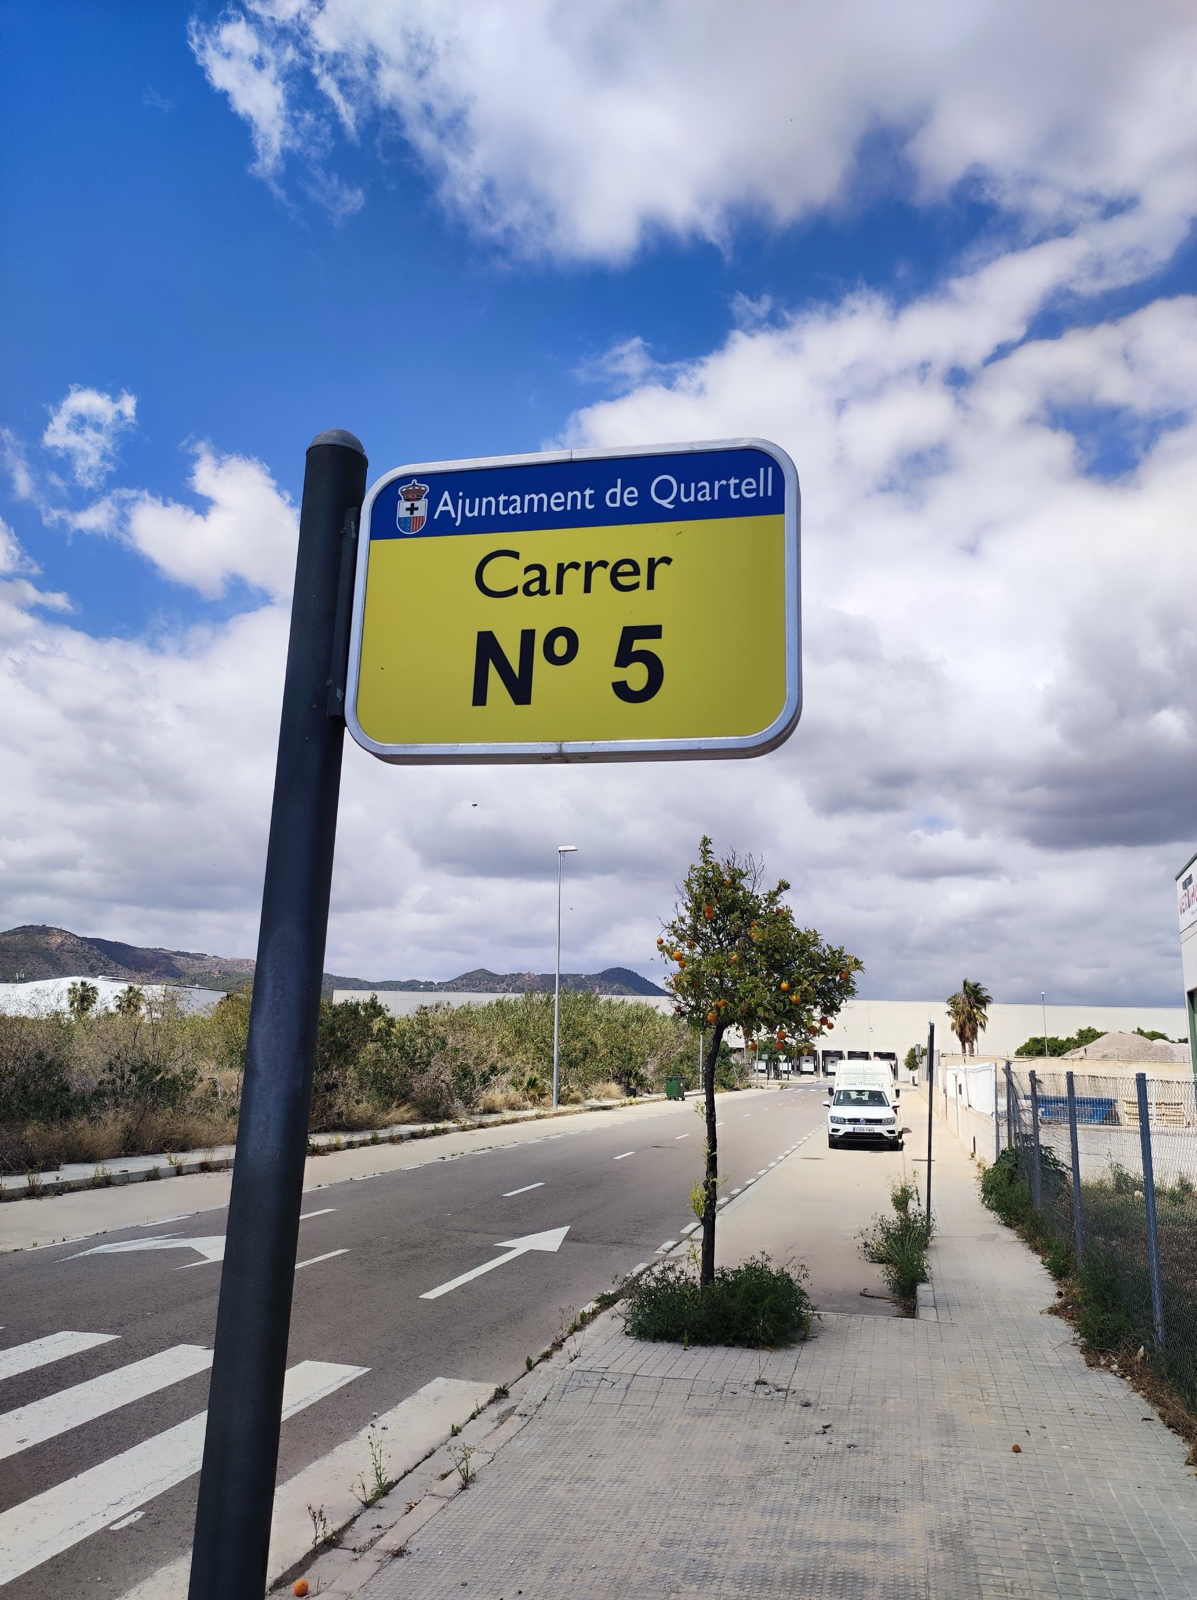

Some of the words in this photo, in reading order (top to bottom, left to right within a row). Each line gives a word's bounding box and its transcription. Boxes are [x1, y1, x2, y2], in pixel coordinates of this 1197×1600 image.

[433, 488, 595, 526] Ajuntament
[605, 478, 639, 507] de
[650, 467, 774, 509] Quartell
[474, 549, 673, 598] Carrer
[471, 626, 579, 706] Nº
[611, 624, 664, 703] 5
